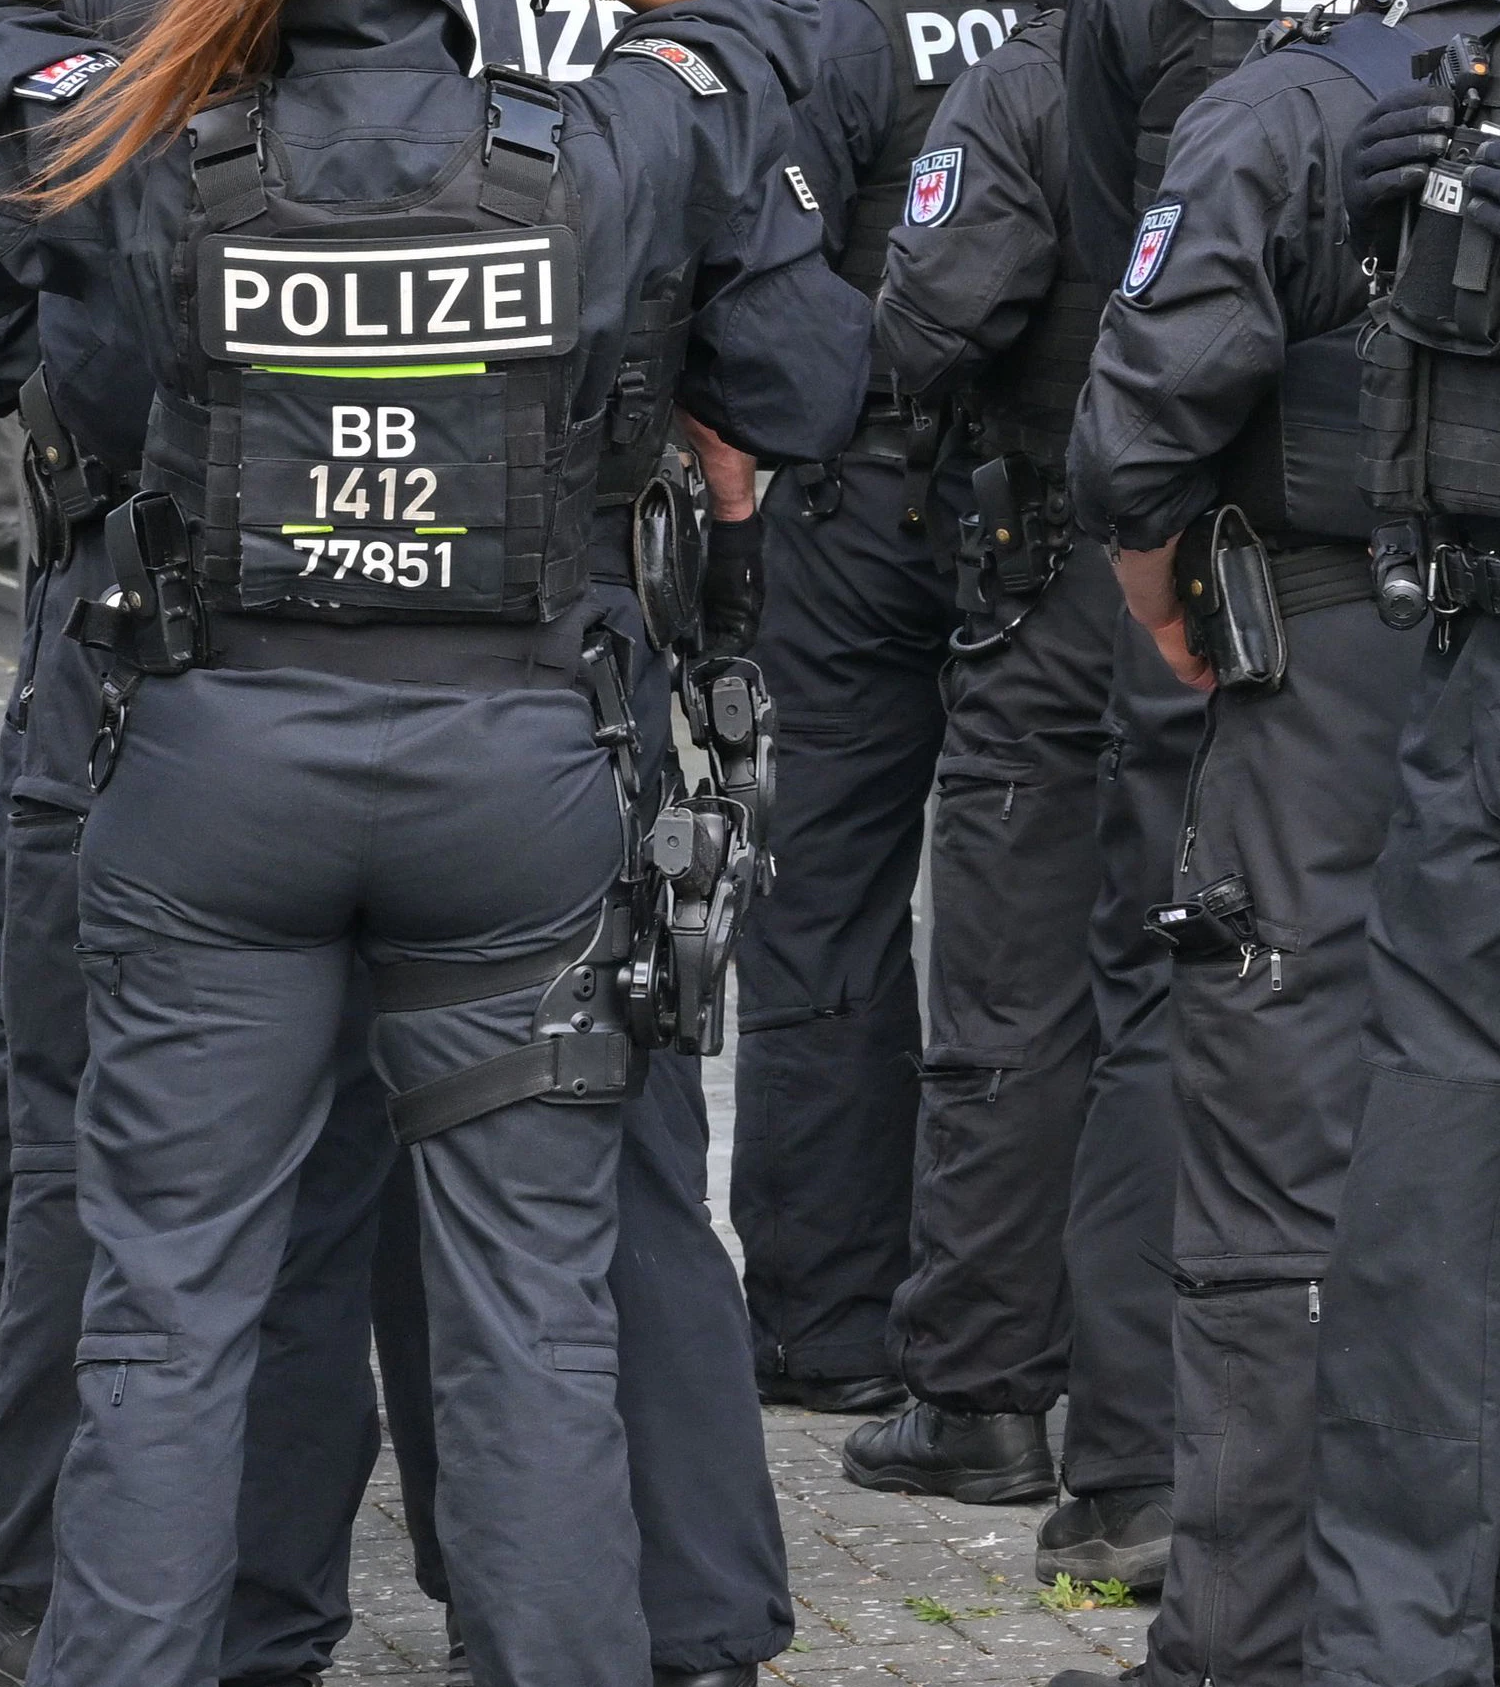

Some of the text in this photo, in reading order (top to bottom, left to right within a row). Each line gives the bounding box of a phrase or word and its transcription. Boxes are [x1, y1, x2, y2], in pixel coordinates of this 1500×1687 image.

[51, 58, 119, 96] POLIZEI
[914, 153, 957, 178] POLIZEI
[1141, 211, 1178, 232] POLIZEI
[223, 260, 553, 336] POLIZEI
[331, 405, 417, 459] BB
[309, 464, 438, 521] 1412
[293, 539, 452, 589] 77851
